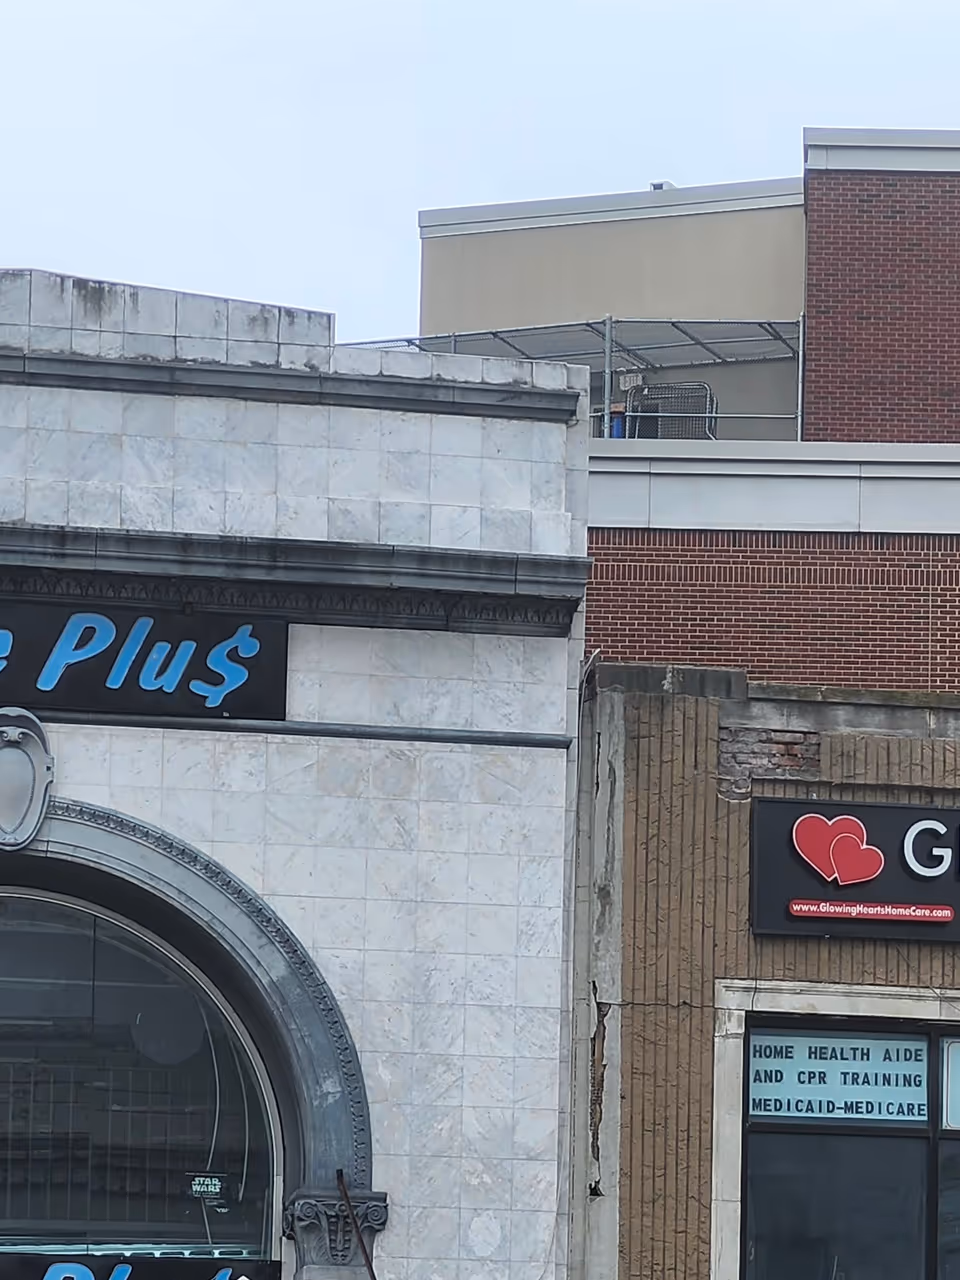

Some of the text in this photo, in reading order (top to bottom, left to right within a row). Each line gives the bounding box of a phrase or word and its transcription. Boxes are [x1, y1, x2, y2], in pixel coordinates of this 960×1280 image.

[36, 612, 260, 708] Plu$
[792, 901, 951, 919] www.GlowingHeartsHomeCare.com
[752, 1044, 924, 1062] HOME HEALTH AIDE
[753, 1070, 923, 1088] AND CPR TRAINING
[752, 1098, 927, 1117] MEDICAID-MEDICARE
[191, 1177, 221, 1185] STAR
[191, 1184, 222, 1192] WARS
